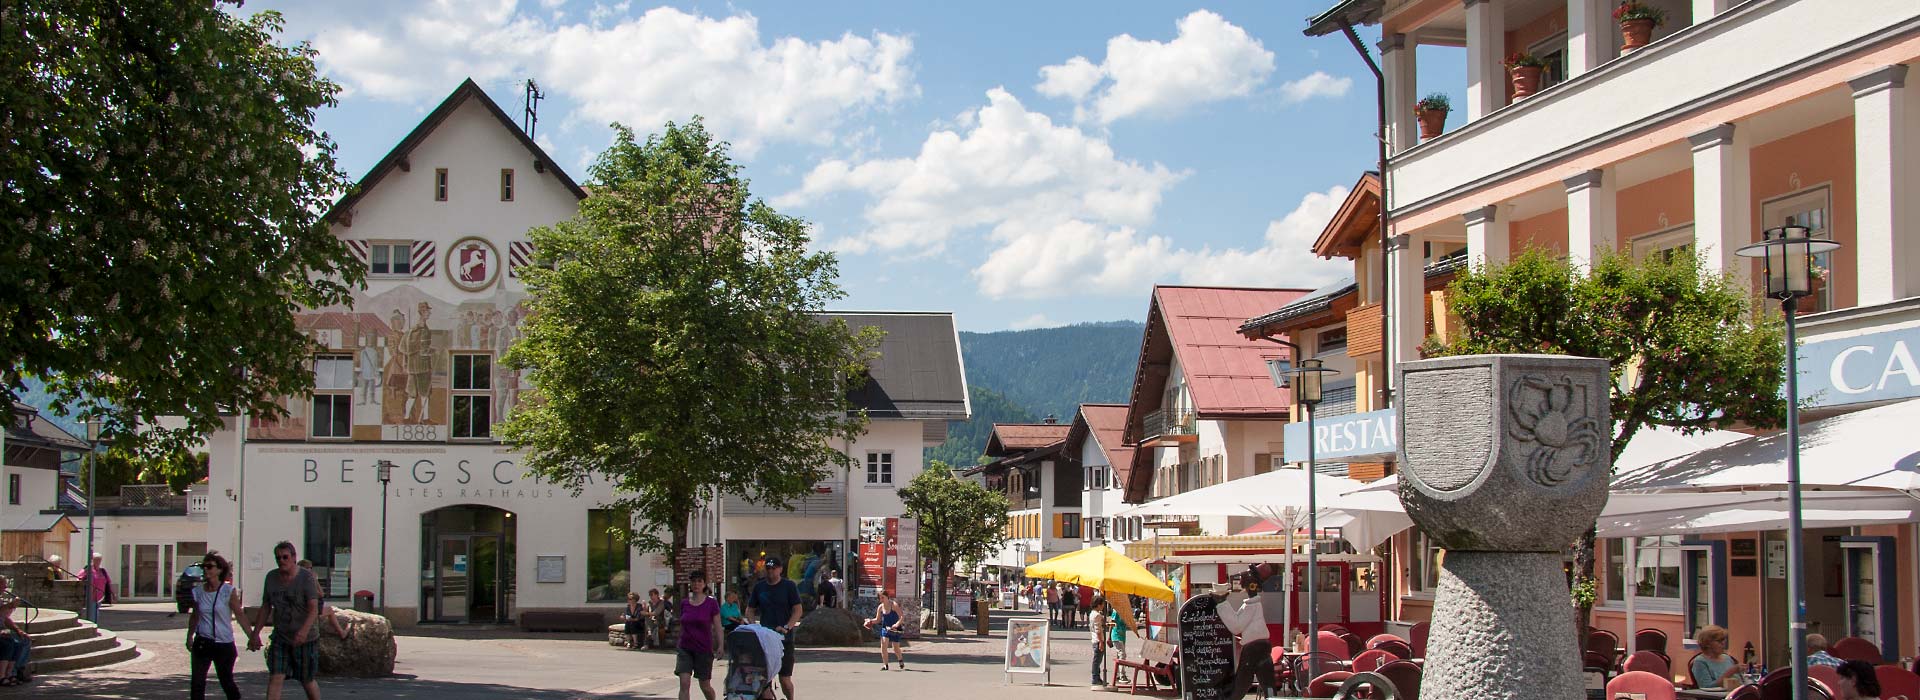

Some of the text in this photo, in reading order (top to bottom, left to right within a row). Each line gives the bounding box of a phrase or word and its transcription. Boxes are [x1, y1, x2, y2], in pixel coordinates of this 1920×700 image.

[1830, 340, 1920, 394] CA
[391, 425, 437, 441] 1888
[460, 488, 553, 498] RATHAUS
